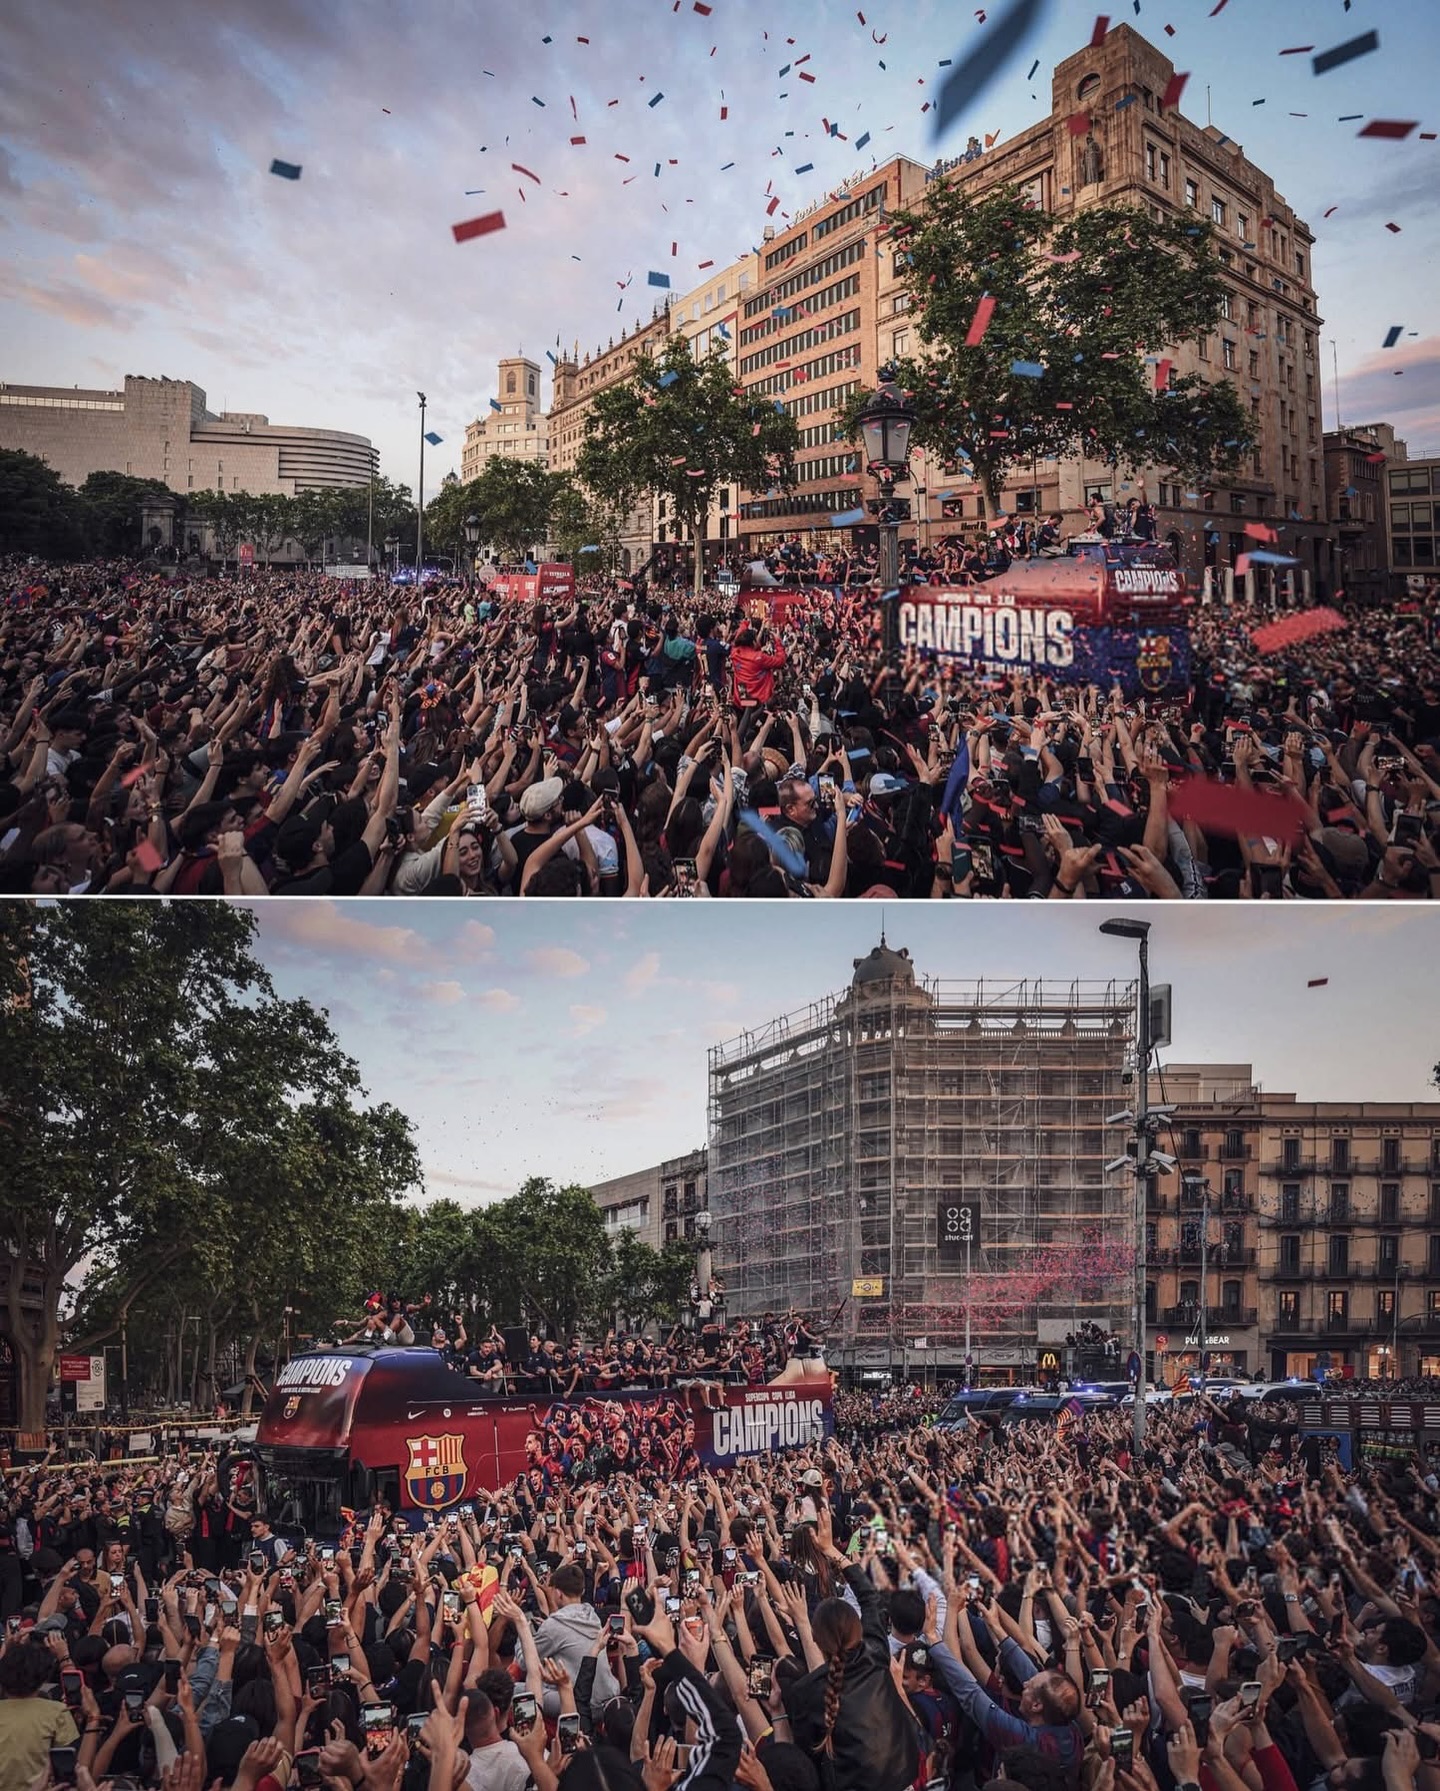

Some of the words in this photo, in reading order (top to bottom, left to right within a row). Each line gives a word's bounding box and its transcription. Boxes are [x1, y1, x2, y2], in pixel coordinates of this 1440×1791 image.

[1114, 569, 1180, 593] CAMPIONS
[899, 602, 1075, 668] CAMPIONS
[1185, 1336, 1230, 1345] PU&BEAR
[713, 1399, 825, 1456] CAMPIONS
